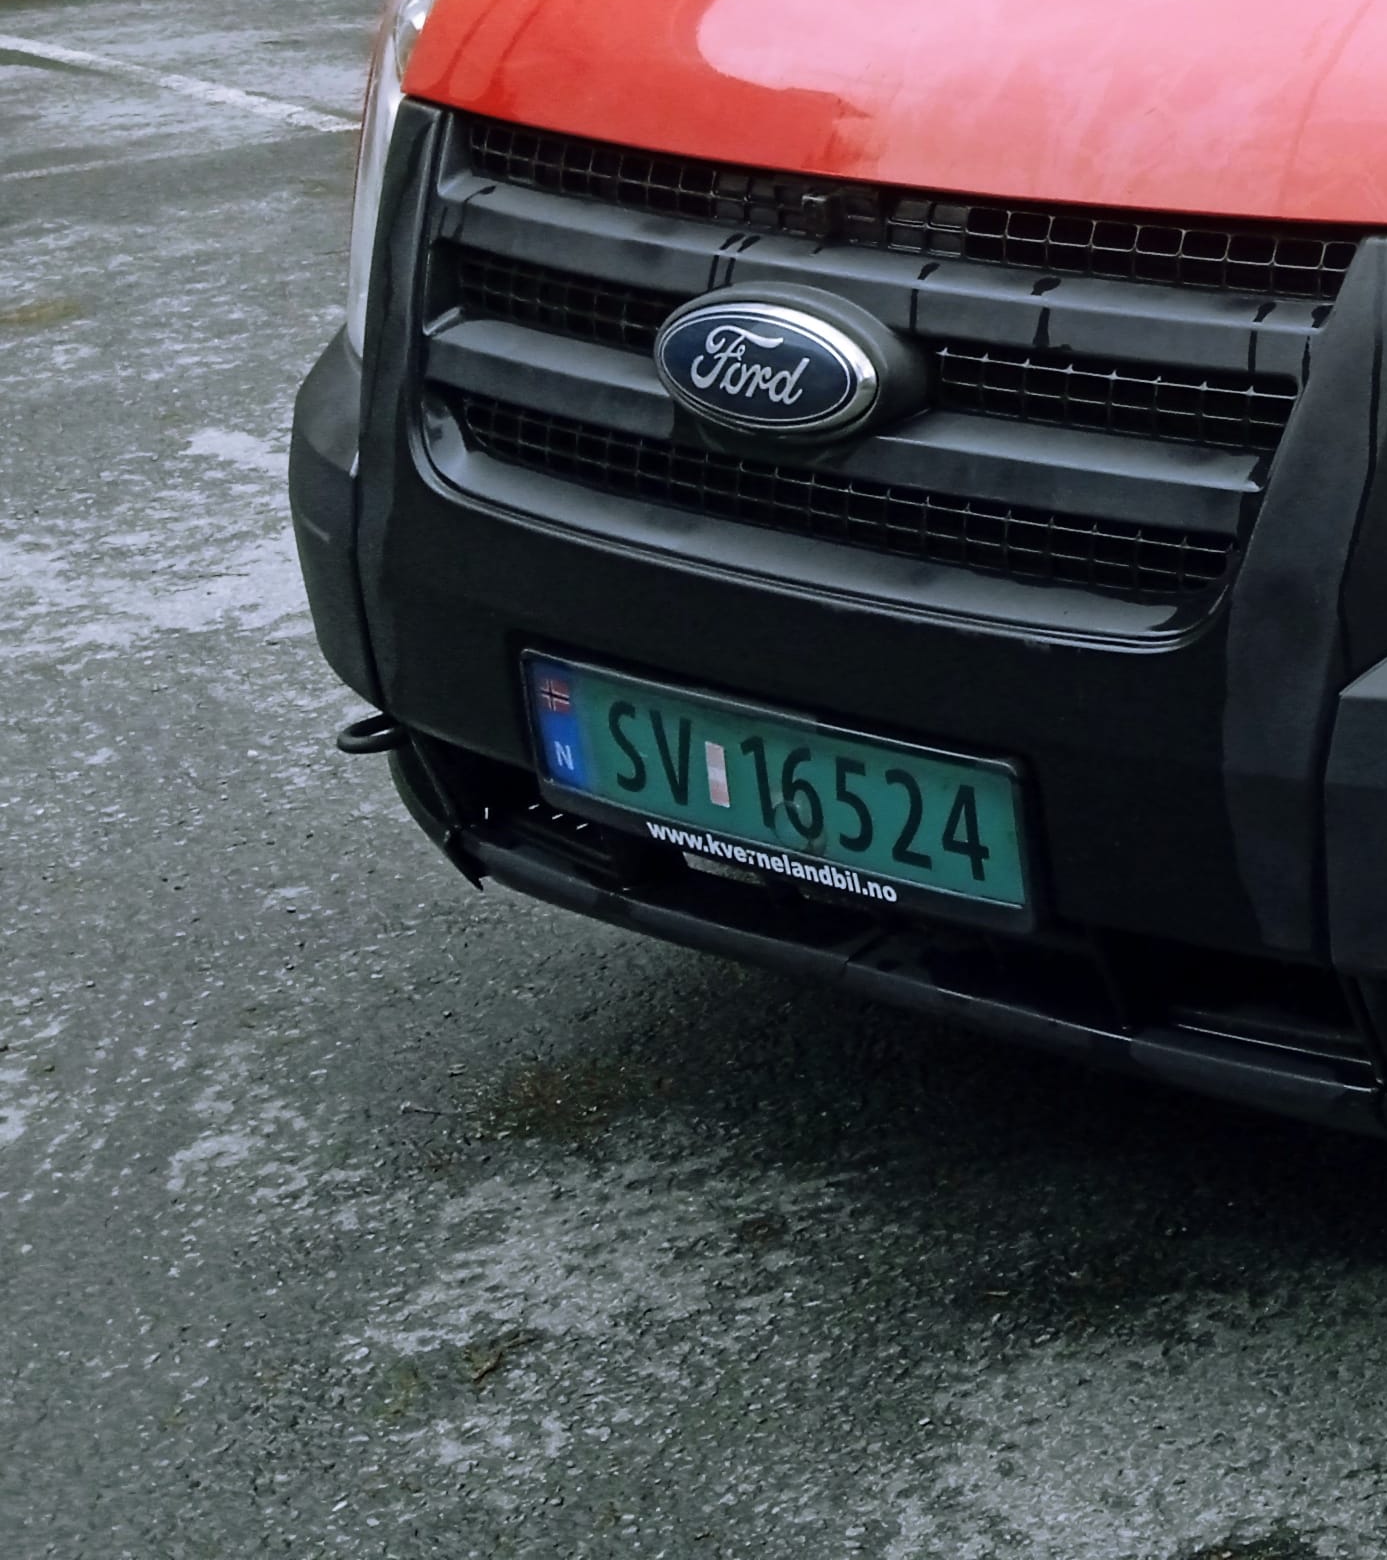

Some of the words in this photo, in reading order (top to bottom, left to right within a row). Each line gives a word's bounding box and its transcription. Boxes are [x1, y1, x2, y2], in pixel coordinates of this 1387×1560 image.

[690, 325, 810, 405] Ford
[554, 741, 573, 771] N
[608, 700, 692, 806] SV
[740, 735, 990, 881] 16524
[646, 821, 898, 903] www.kvernelandbil.no
